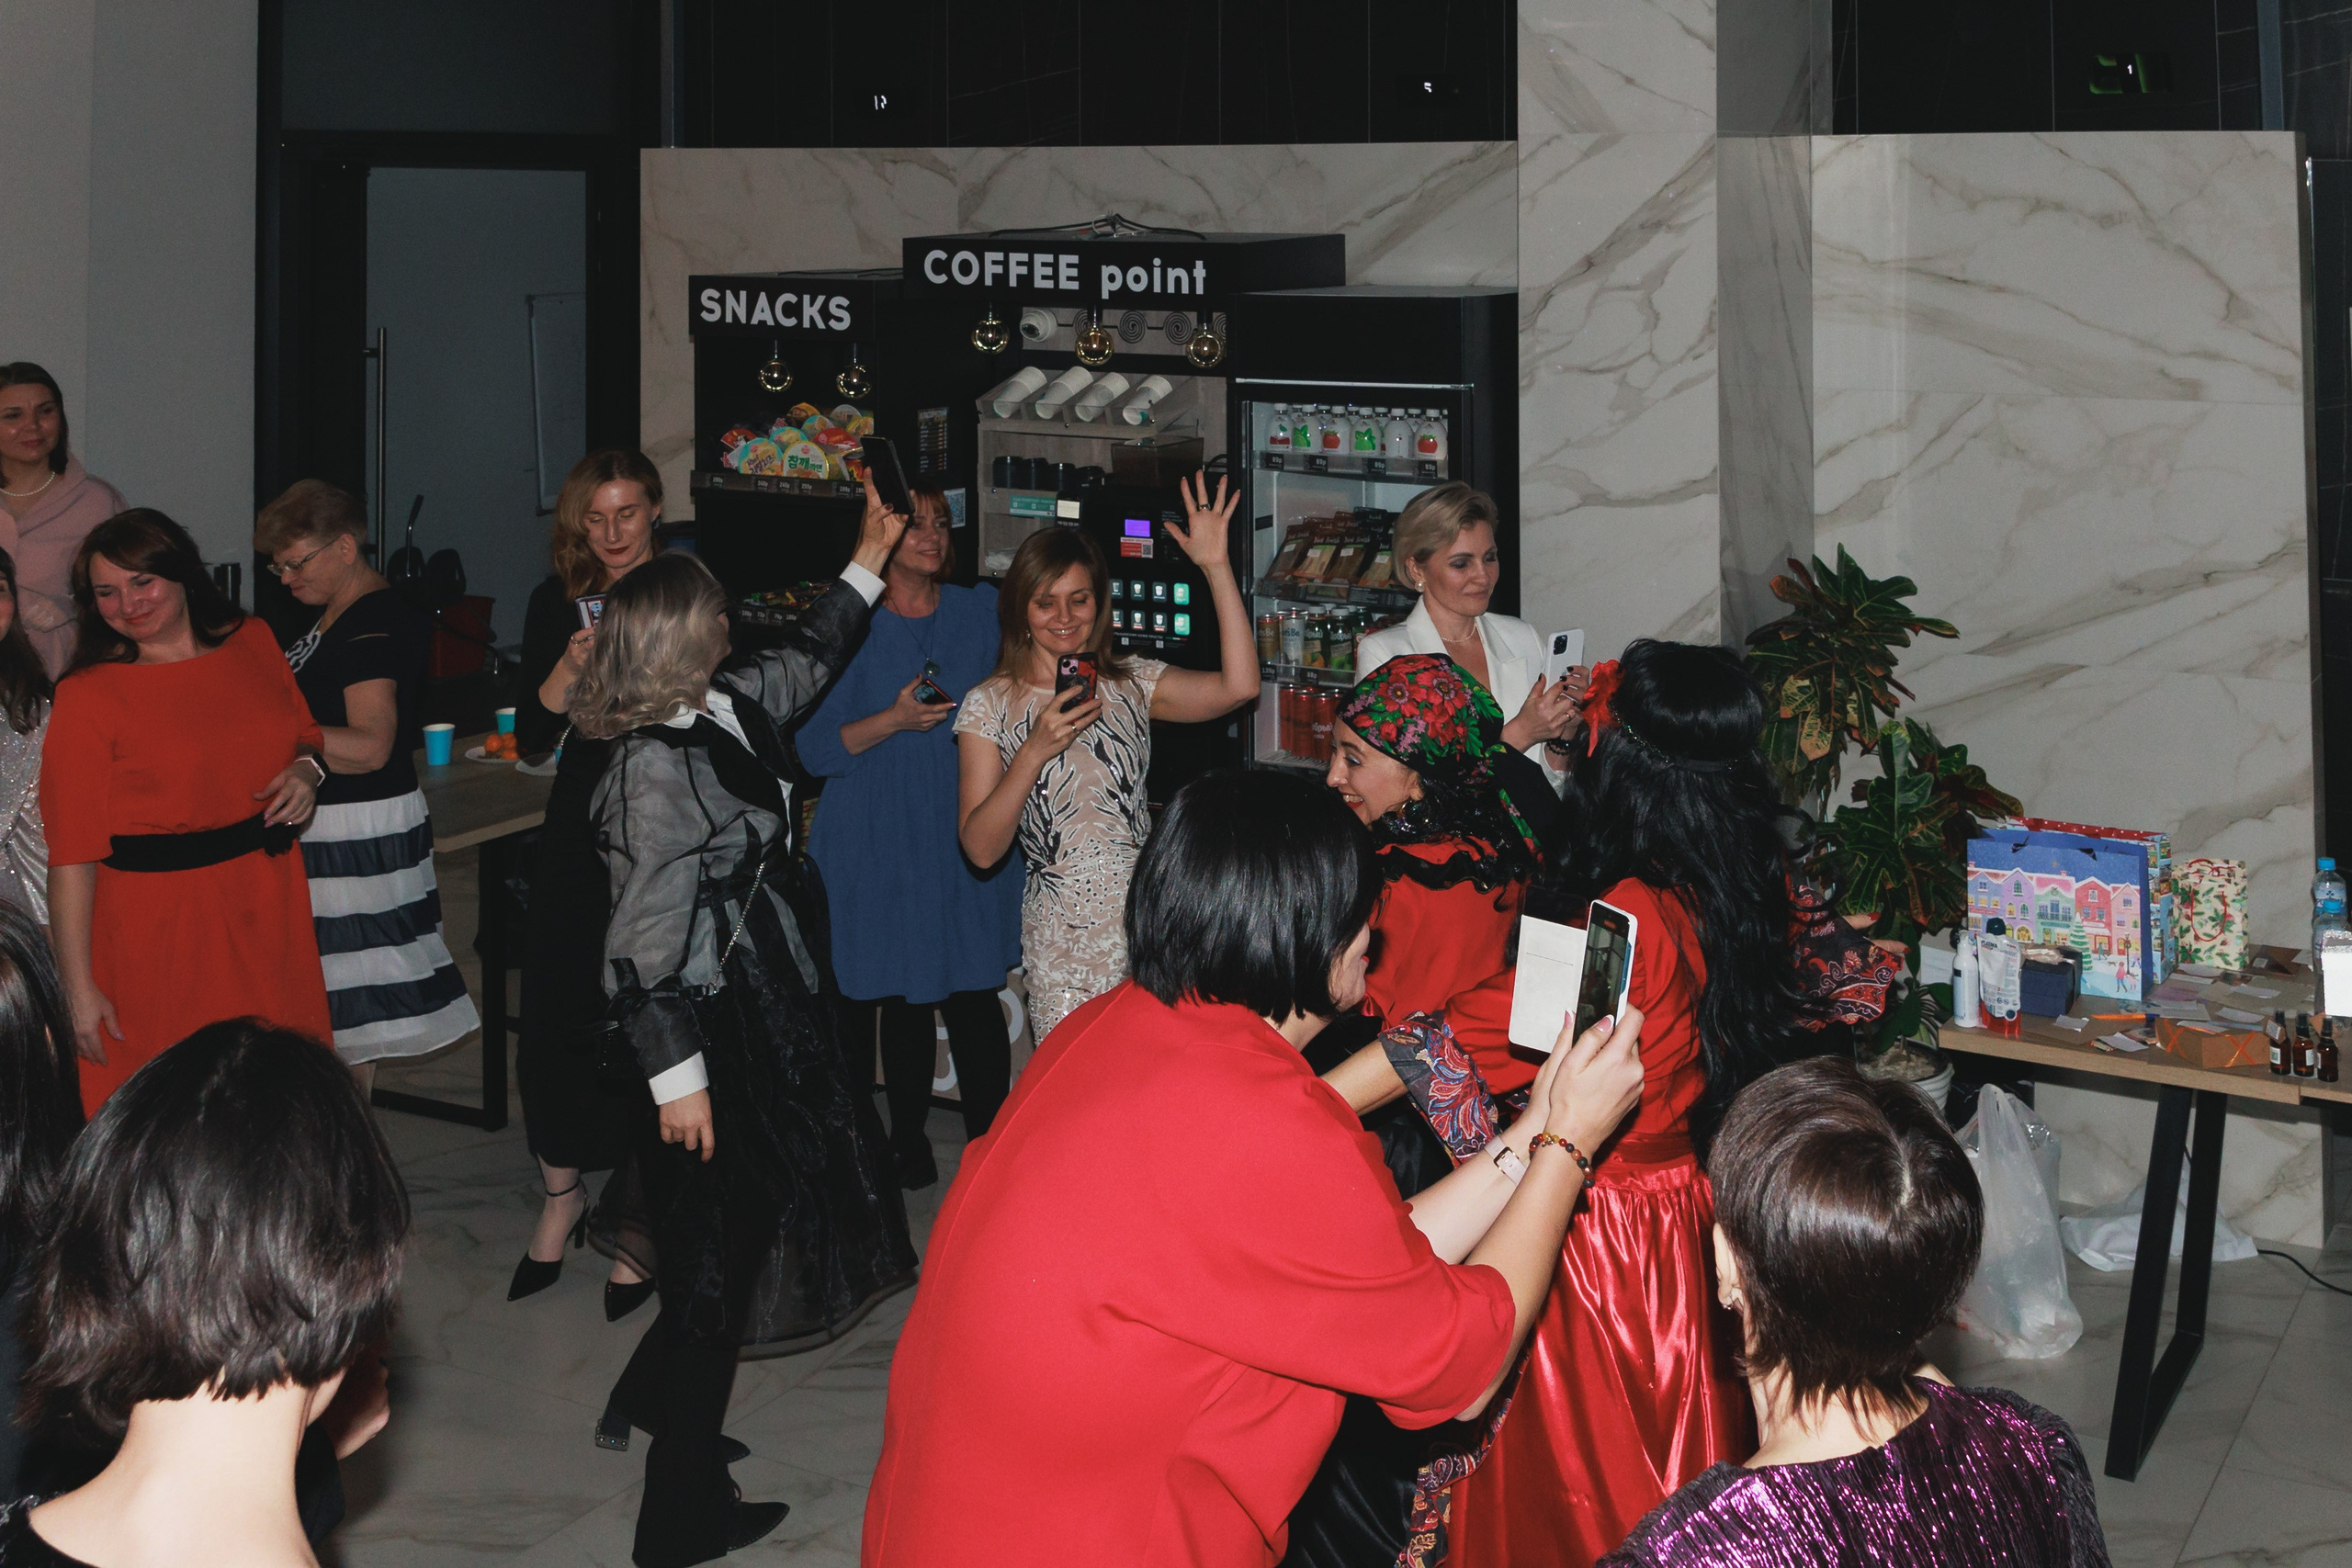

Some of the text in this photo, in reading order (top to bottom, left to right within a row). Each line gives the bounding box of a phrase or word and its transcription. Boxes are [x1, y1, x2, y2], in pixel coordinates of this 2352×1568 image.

[923, 249, 1206, 299] COFFEE point
[700, 287, 852, 331] SNACKS
